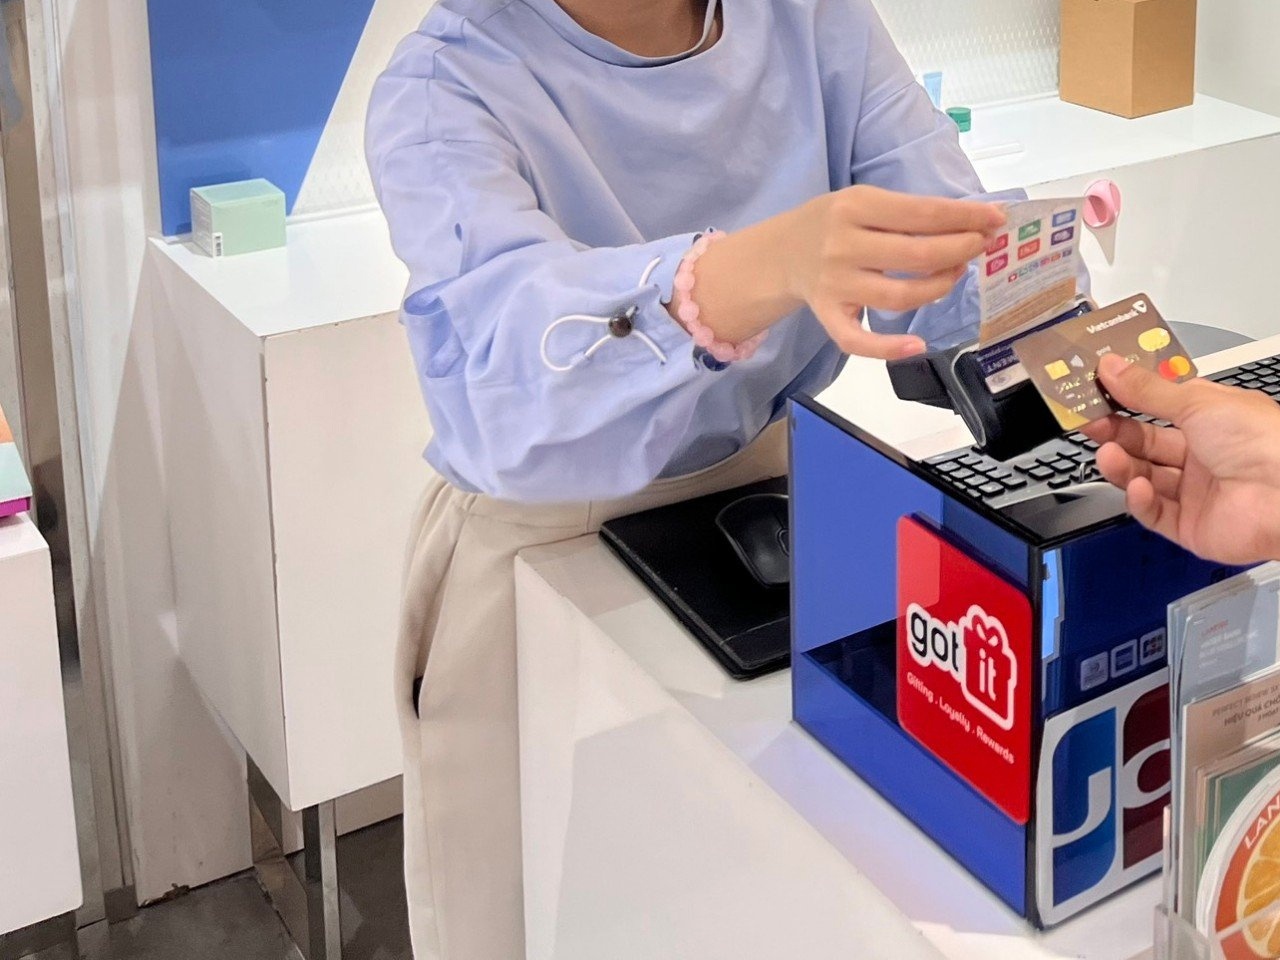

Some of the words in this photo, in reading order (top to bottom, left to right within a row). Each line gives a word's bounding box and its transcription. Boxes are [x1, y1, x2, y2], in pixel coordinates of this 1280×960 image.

[909, 610, 960, 673] got
[979, 648, 997, 702] it
[907, 671, 934, 704] Gifting
[939, 695, 970, 733] Loyalty
[976, 725, 1015, 765] Rewards
